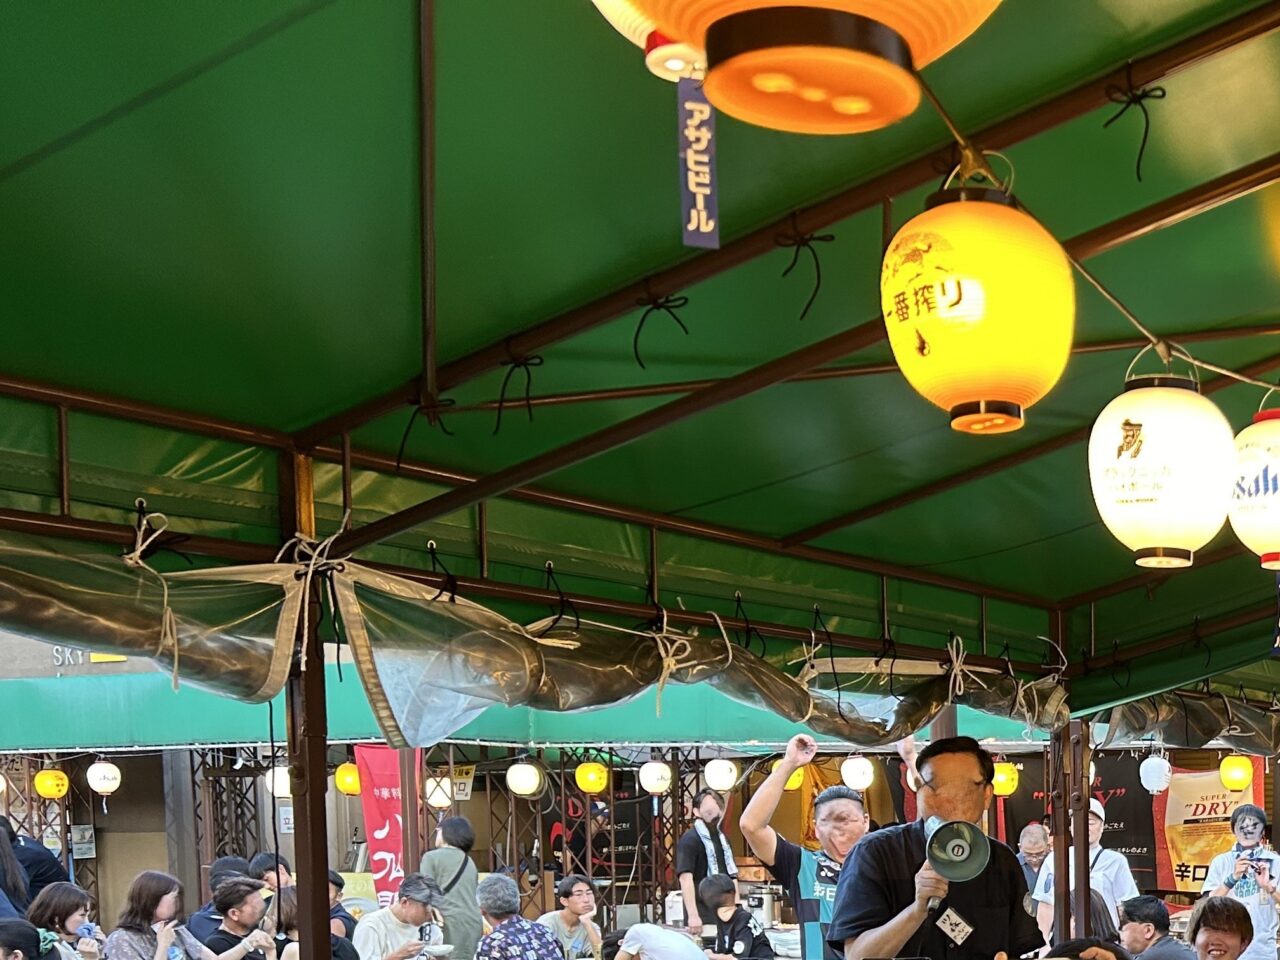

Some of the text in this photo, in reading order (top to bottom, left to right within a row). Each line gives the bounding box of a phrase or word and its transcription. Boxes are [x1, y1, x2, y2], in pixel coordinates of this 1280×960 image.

[684, 101, 715, 233] アサヒビール
[886, 280, 963, 323] 一番搾り
[53, 646, 84, 666] SKY
[1200, 793, 1227, 802] SUPER
[1174, 863, 1208, 882] 辛口
